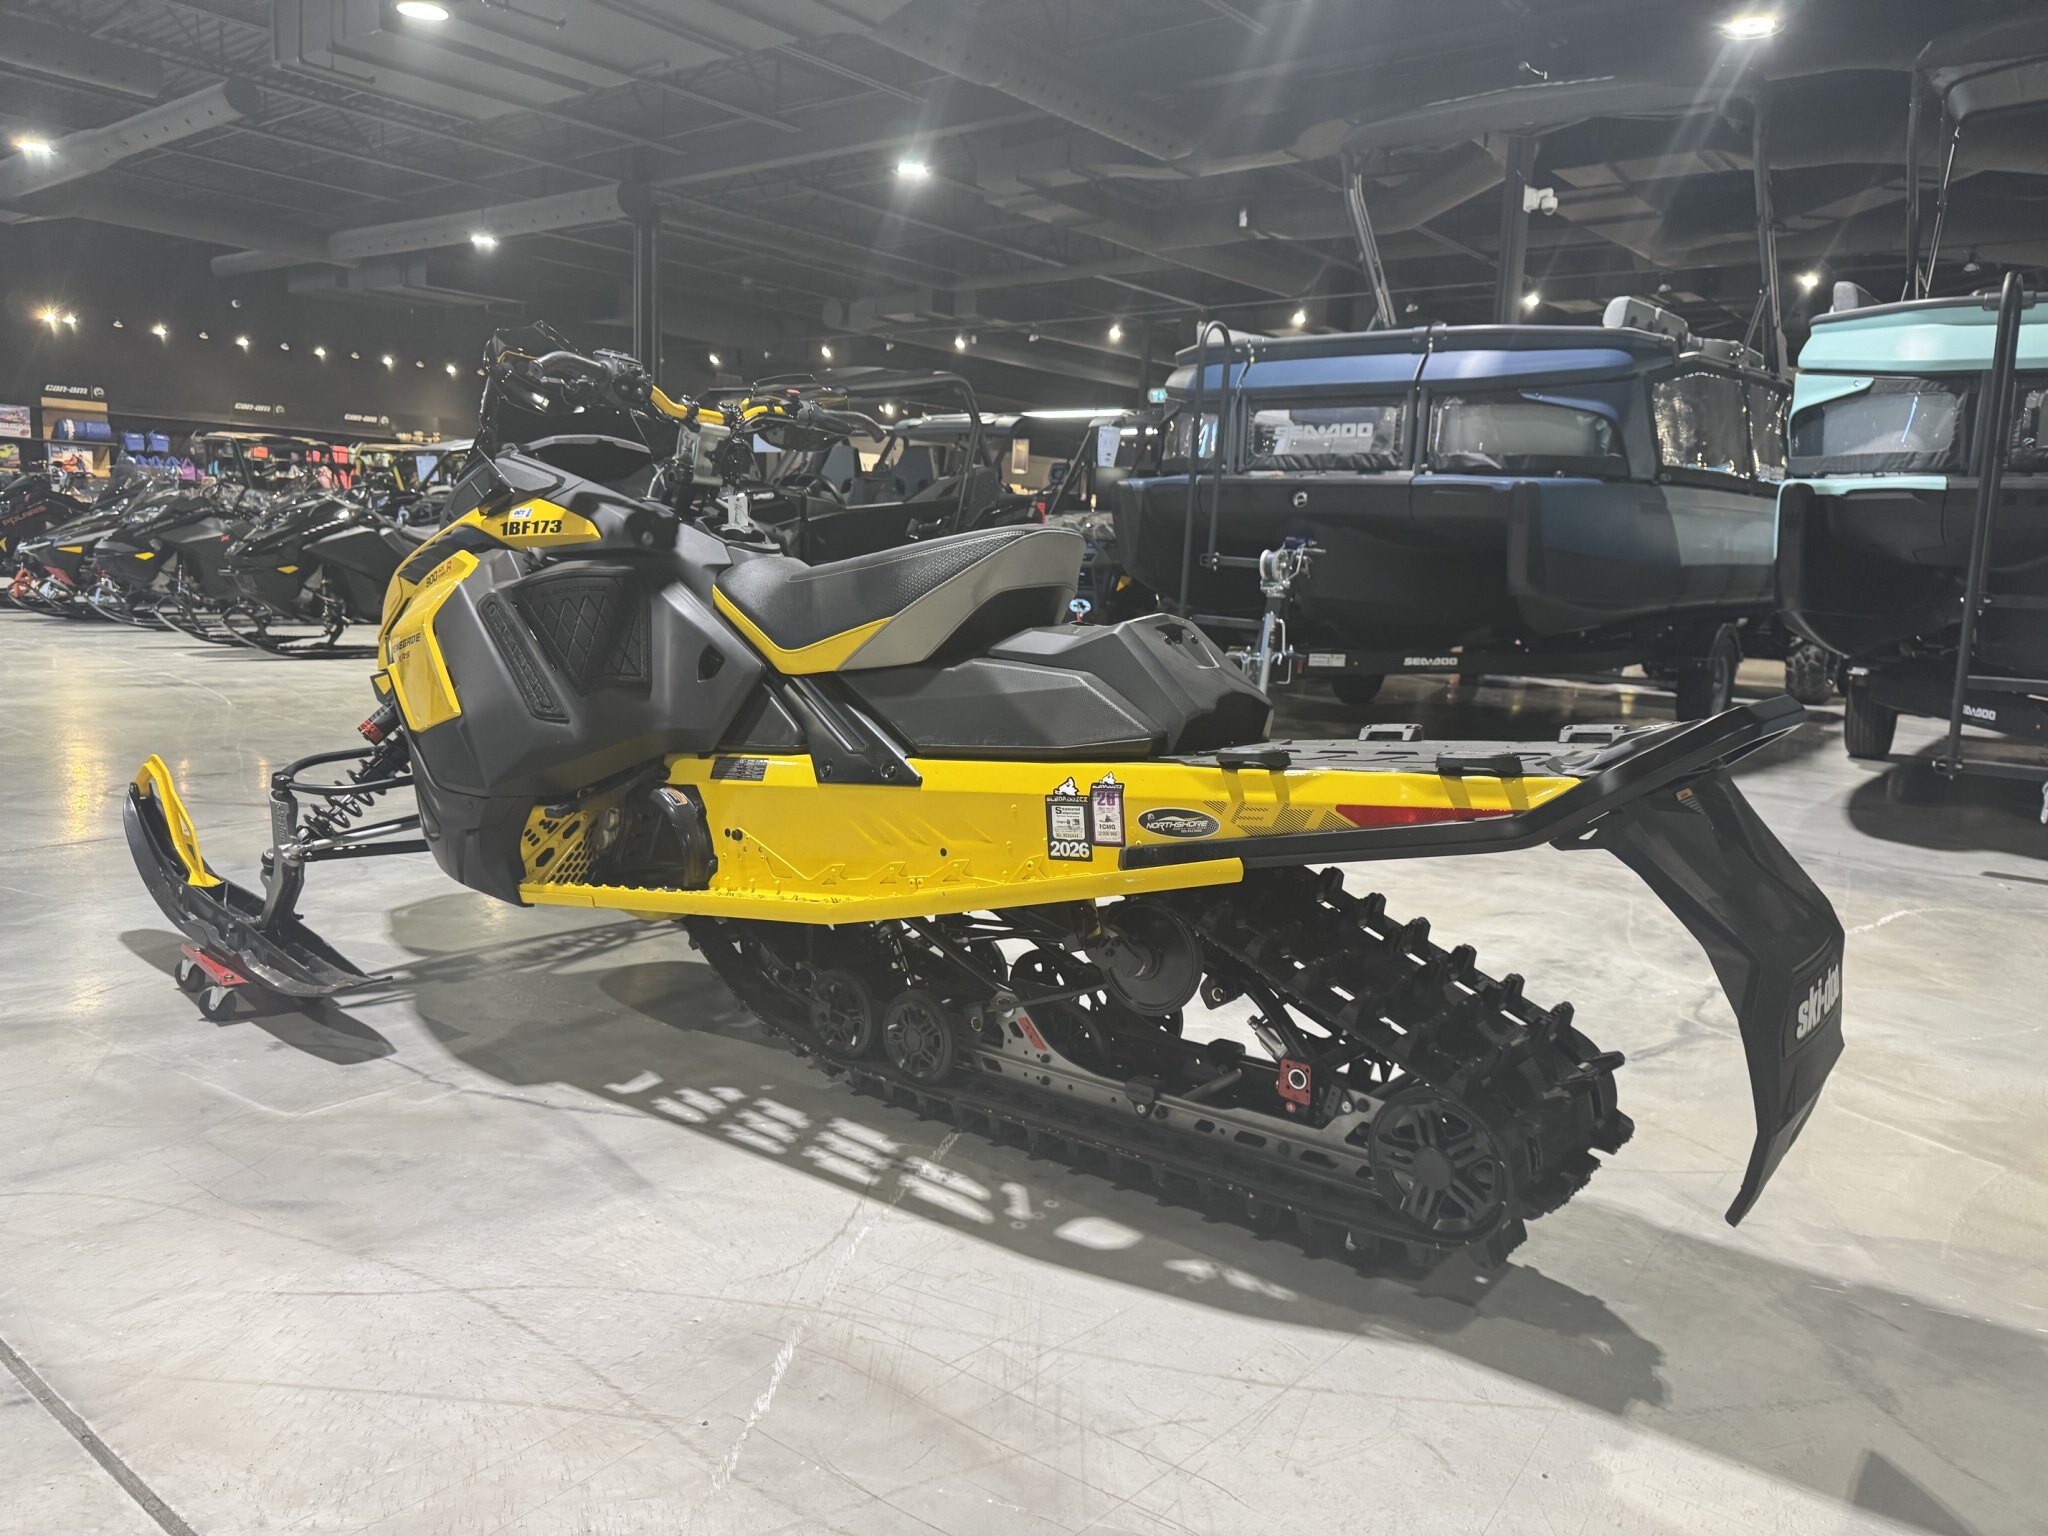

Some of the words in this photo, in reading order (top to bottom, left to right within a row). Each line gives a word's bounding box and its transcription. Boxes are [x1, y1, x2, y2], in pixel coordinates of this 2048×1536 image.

[45, 384, 88, 395] can-am
[500, 519, 563, 536] 1BF173
[426, 570, 437, 588] 900
[1146, 820, 1209, 832] NORTHSHORE
[1050, 840, 1090, 859] 2026
